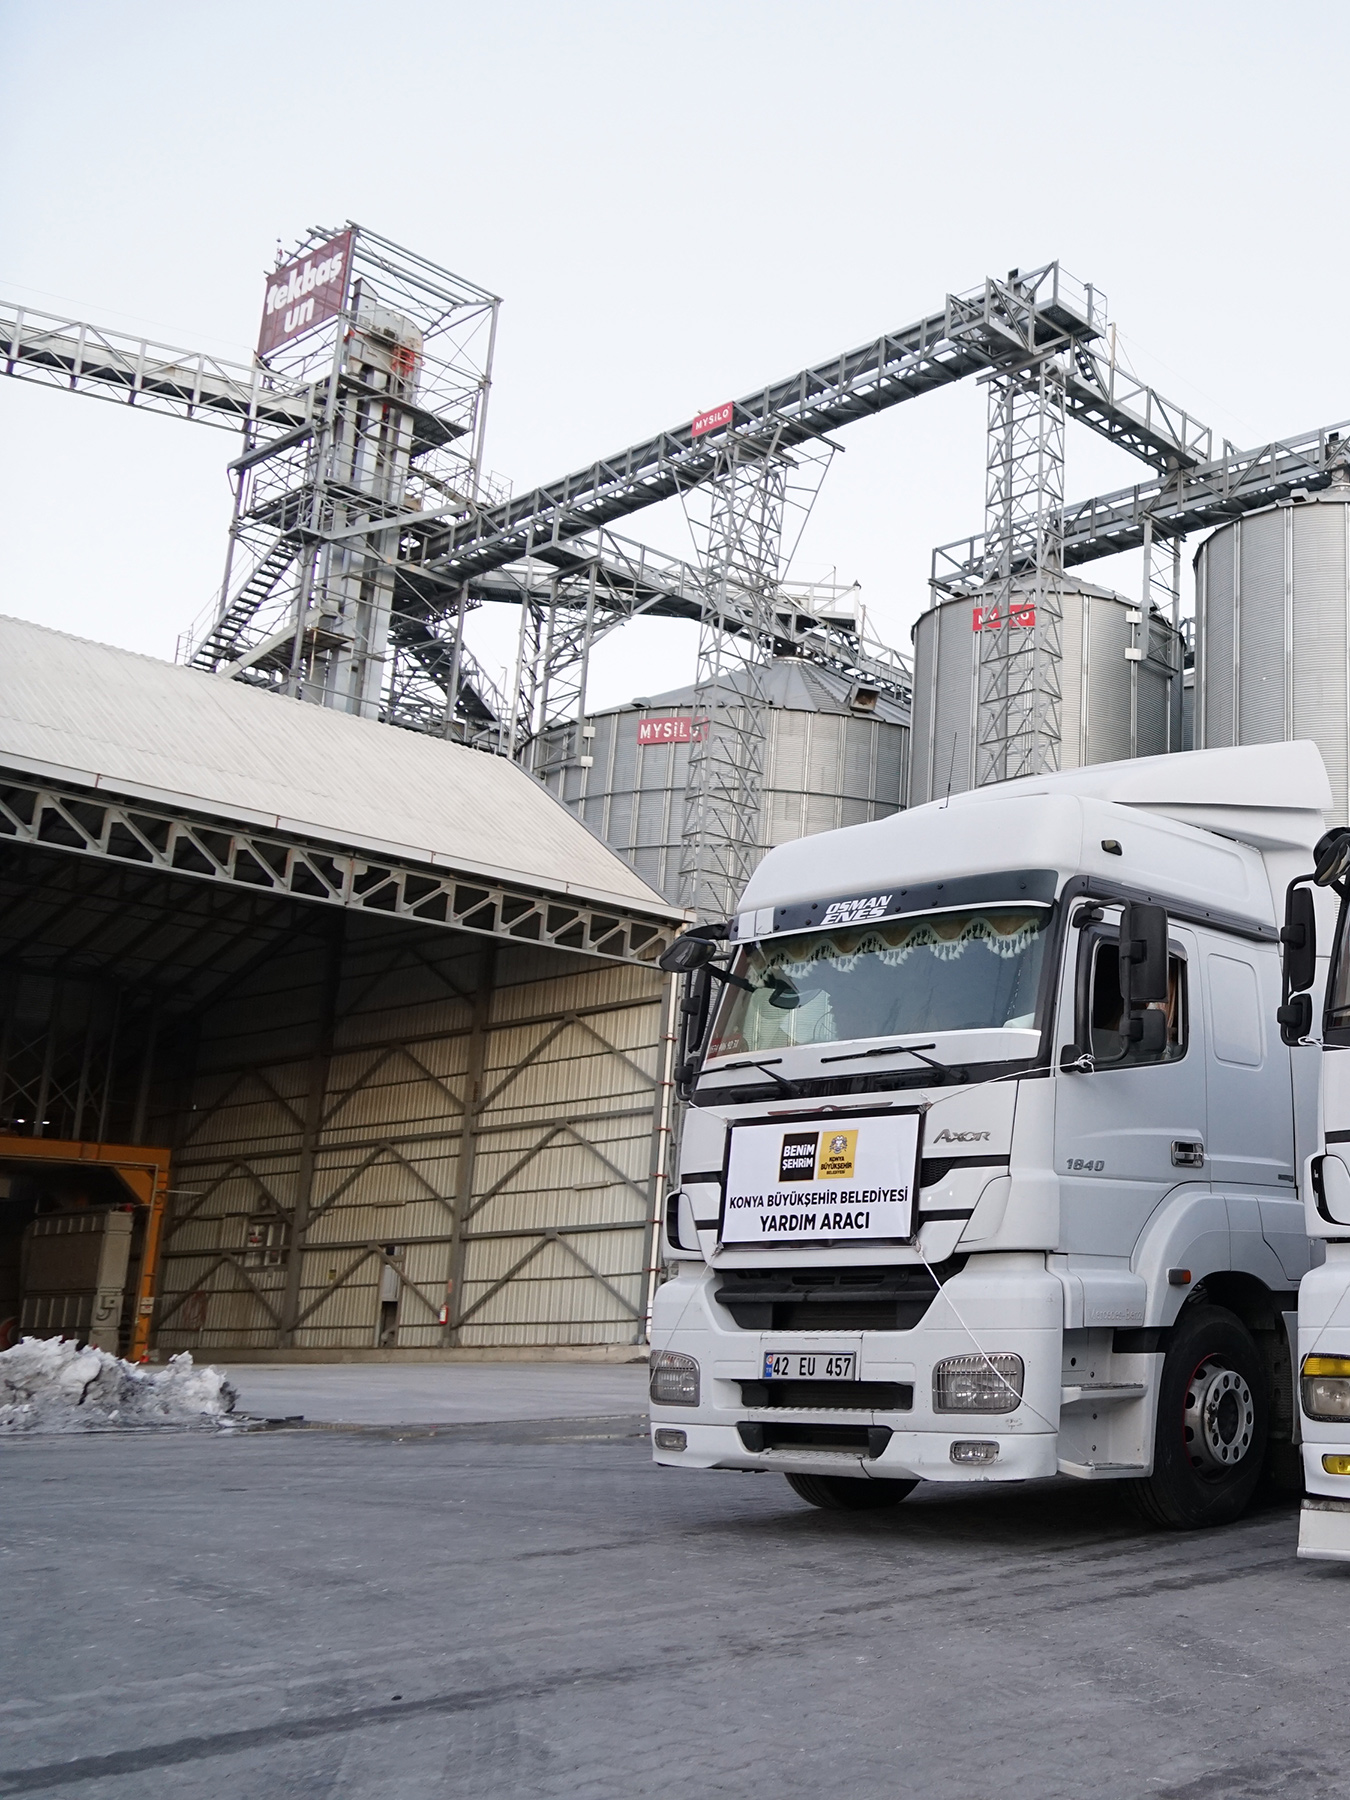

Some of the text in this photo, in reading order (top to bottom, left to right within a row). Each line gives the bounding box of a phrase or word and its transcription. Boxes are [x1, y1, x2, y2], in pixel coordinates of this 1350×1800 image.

[266, 251, 344, 316] tekbaş
[283, 297, 315, 333] un
[825, 894, 893, 915] OSMAN
[820, 905, 888, 925] ENES
[933, 1128, 992, 1144] AXOR
[1066, 1158, 1105, 1172] 1840
[729, 1186, 908, 1209] KONYA BÜYÜKŞEHİR BELEDİYESİ
[760, 1212, 870, 1232] YARDIM ARACI
[773, 1357, 851, 1376] 42 EU 457
